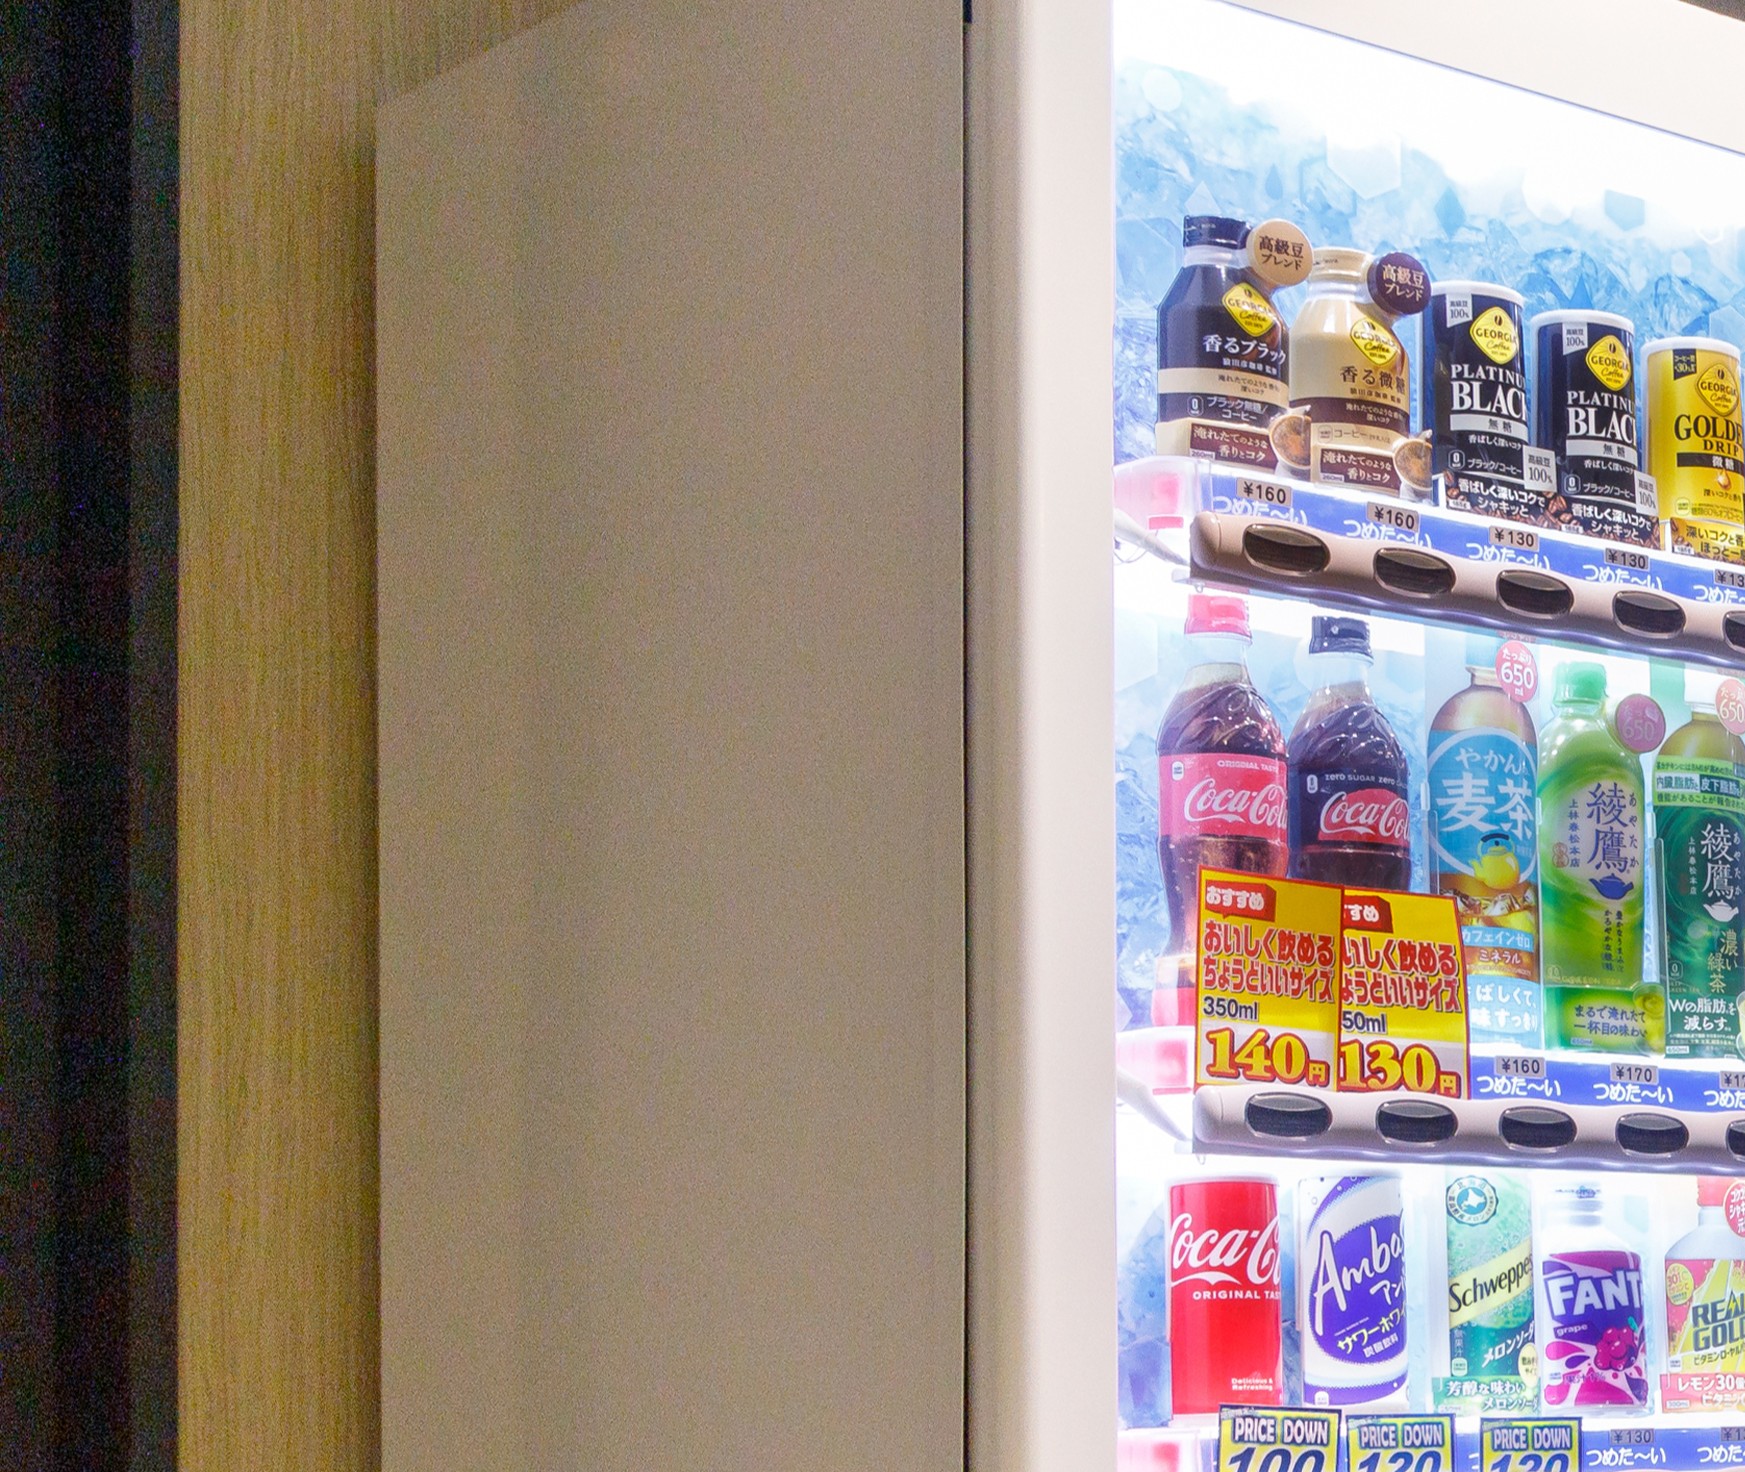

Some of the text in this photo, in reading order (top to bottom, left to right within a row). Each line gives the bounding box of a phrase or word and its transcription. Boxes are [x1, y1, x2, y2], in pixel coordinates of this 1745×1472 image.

[1260, 236, 1304, 259] 高級豆
[1262, 253, 1301, 269] ブレンド
[1382, 264, 1424, 289] 高級豆
[1384, 283, 1423, 301] ブレンド
[1703, 439, 1739, 456] DRIP
[1243, 483, 1286, 502] ¥160
[1374, 507, 1414, 529] ¥160
[1494, 529, 1534, 547] ¥130
[1608, 552, 1647, 568] ¥130
[1500, 666, 1534, 685] 650
[1719, 701, 1745, 722] 650
[1436, 772, 1534, 840] 麦茶
[1587, 782, 1629, 872] 綾鷹
[1628, 792, 1640, 868] あやたか
[1206, 886, 1264, 912] おすすめ
[1203, 919, 1335, 968] おいしく飲める
[1479, 950, 1521, 964] ミネラル
[1203, 956, 1334, 1003] ちょうどいいサイズ
[1203, 996, 1258, 1020] 350ml
[1575, 1005, 1646, 1022] まるで淹れたて
[1206, 1027, 1330, 1085] 140円
[1501, 1058, 1540, 1073] ¥160
[1615, 1067, 1652, 1082] ¥170
[1557, 1323, 1588, 1336] grape
[1234, 1418, 1329, 1445] PRICE DOWN
[1361, 1424, 1443, 1447] PRICE DOWN
[1494, 1427, 1571, 1449] PRICE DOWN
